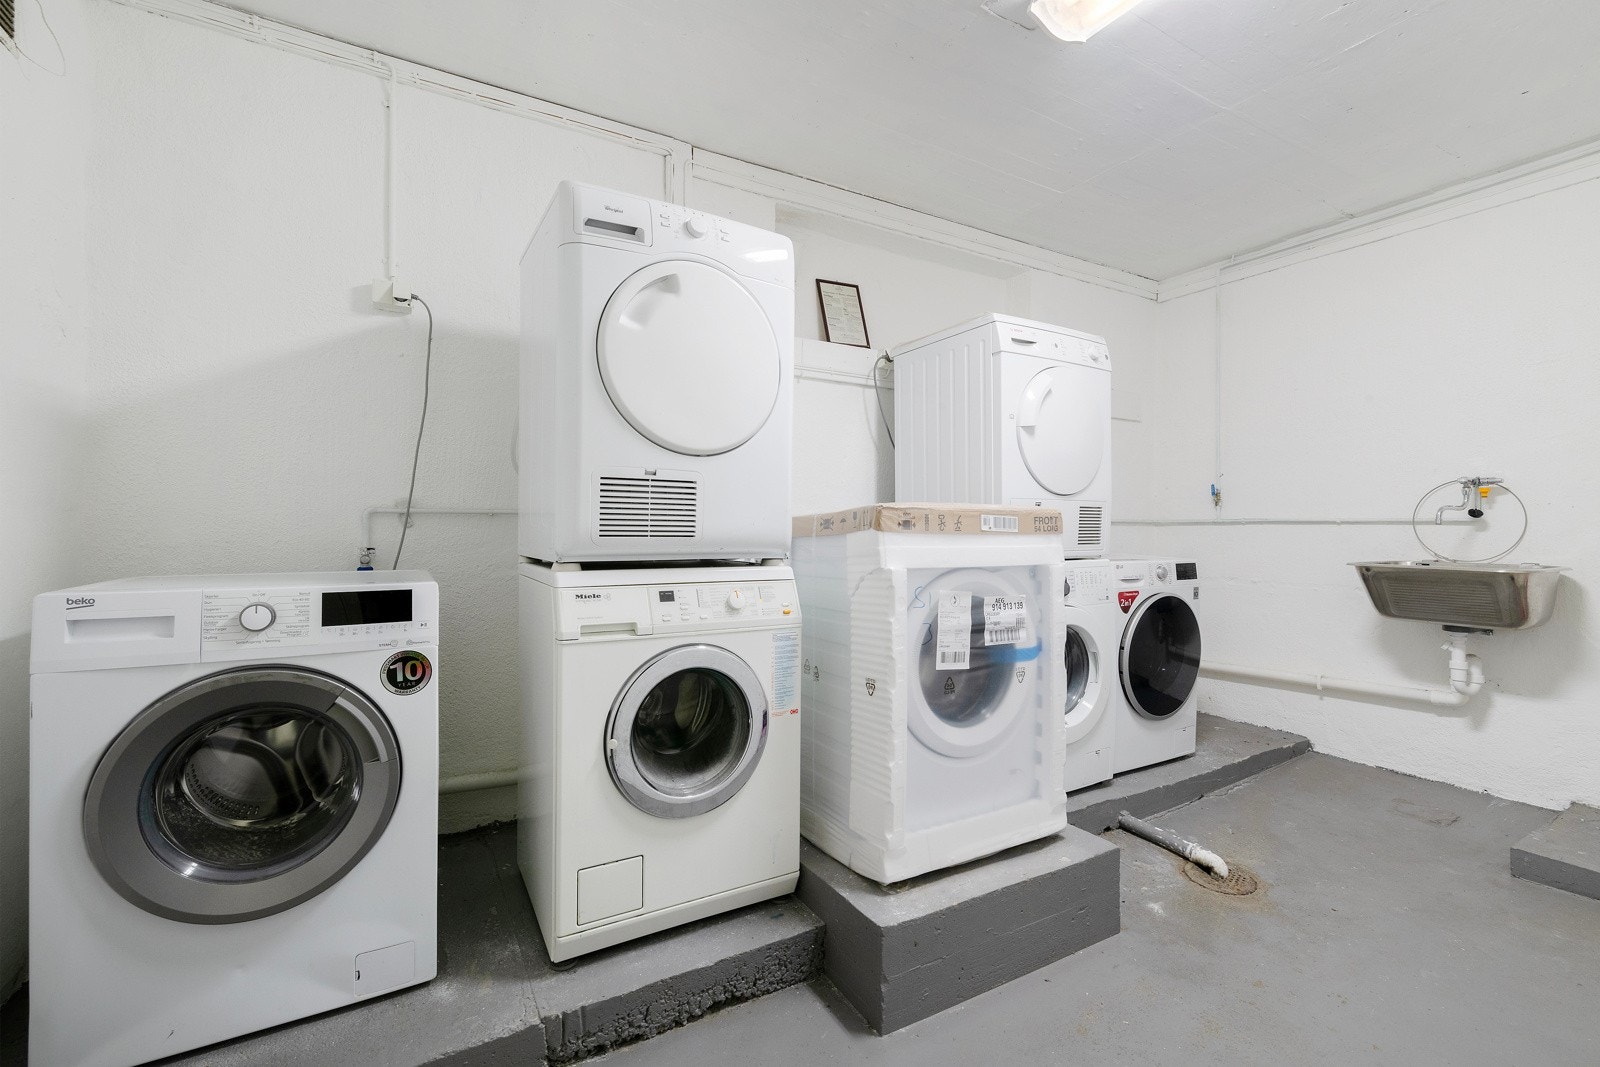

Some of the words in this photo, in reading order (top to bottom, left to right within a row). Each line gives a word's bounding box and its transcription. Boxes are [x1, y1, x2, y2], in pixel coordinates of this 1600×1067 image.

[66, 597, 96, 606] beko
[991, 603, 1002, 611] 914
[1002, 602, 1013, 610] 913
[1014, 601, 1024, 610] 139
[389, 660, 423, 682] 10
[394, 686, 421, 694] WARRANTY
